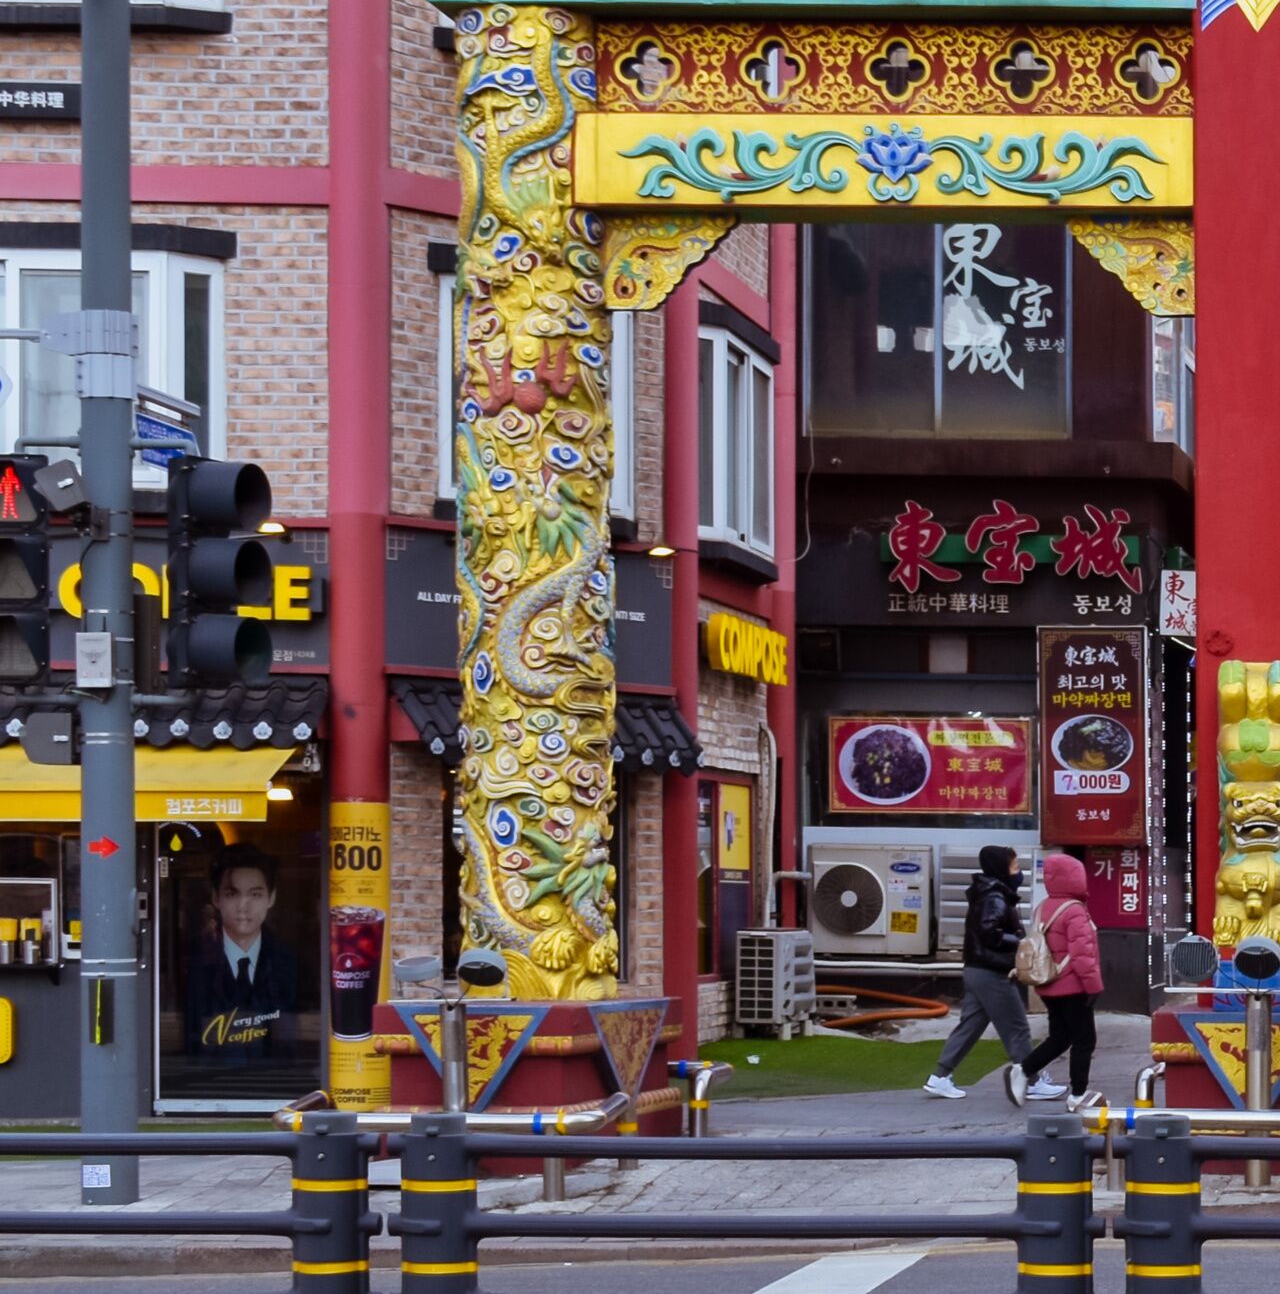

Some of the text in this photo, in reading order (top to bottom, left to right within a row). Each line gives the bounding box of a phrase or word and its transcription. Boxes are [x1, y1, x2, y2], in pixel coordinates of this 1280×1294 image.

[0, 90, 65, 109] 中华料理
[1023, 337, 1066, 355] 동보성
[1072, 594, 1133, 616] 동보성
[719, 612, 788, 686] COMPOSE
[1057, 673, 1127, 691] 최고의 맛
[1052, 691, 1133, 708] 마약짜장면
[166, 797, 244, 816] 컴포즈커피
[333, 970, 370, 980] COMPOSE
[336, 980, 365, 989] COFFEE
[228, 1028, 268, 1044] coffee
[334, 1088, 371, 1096] COMPOSE
[337, 1096, 367, 1104] COFFEE
